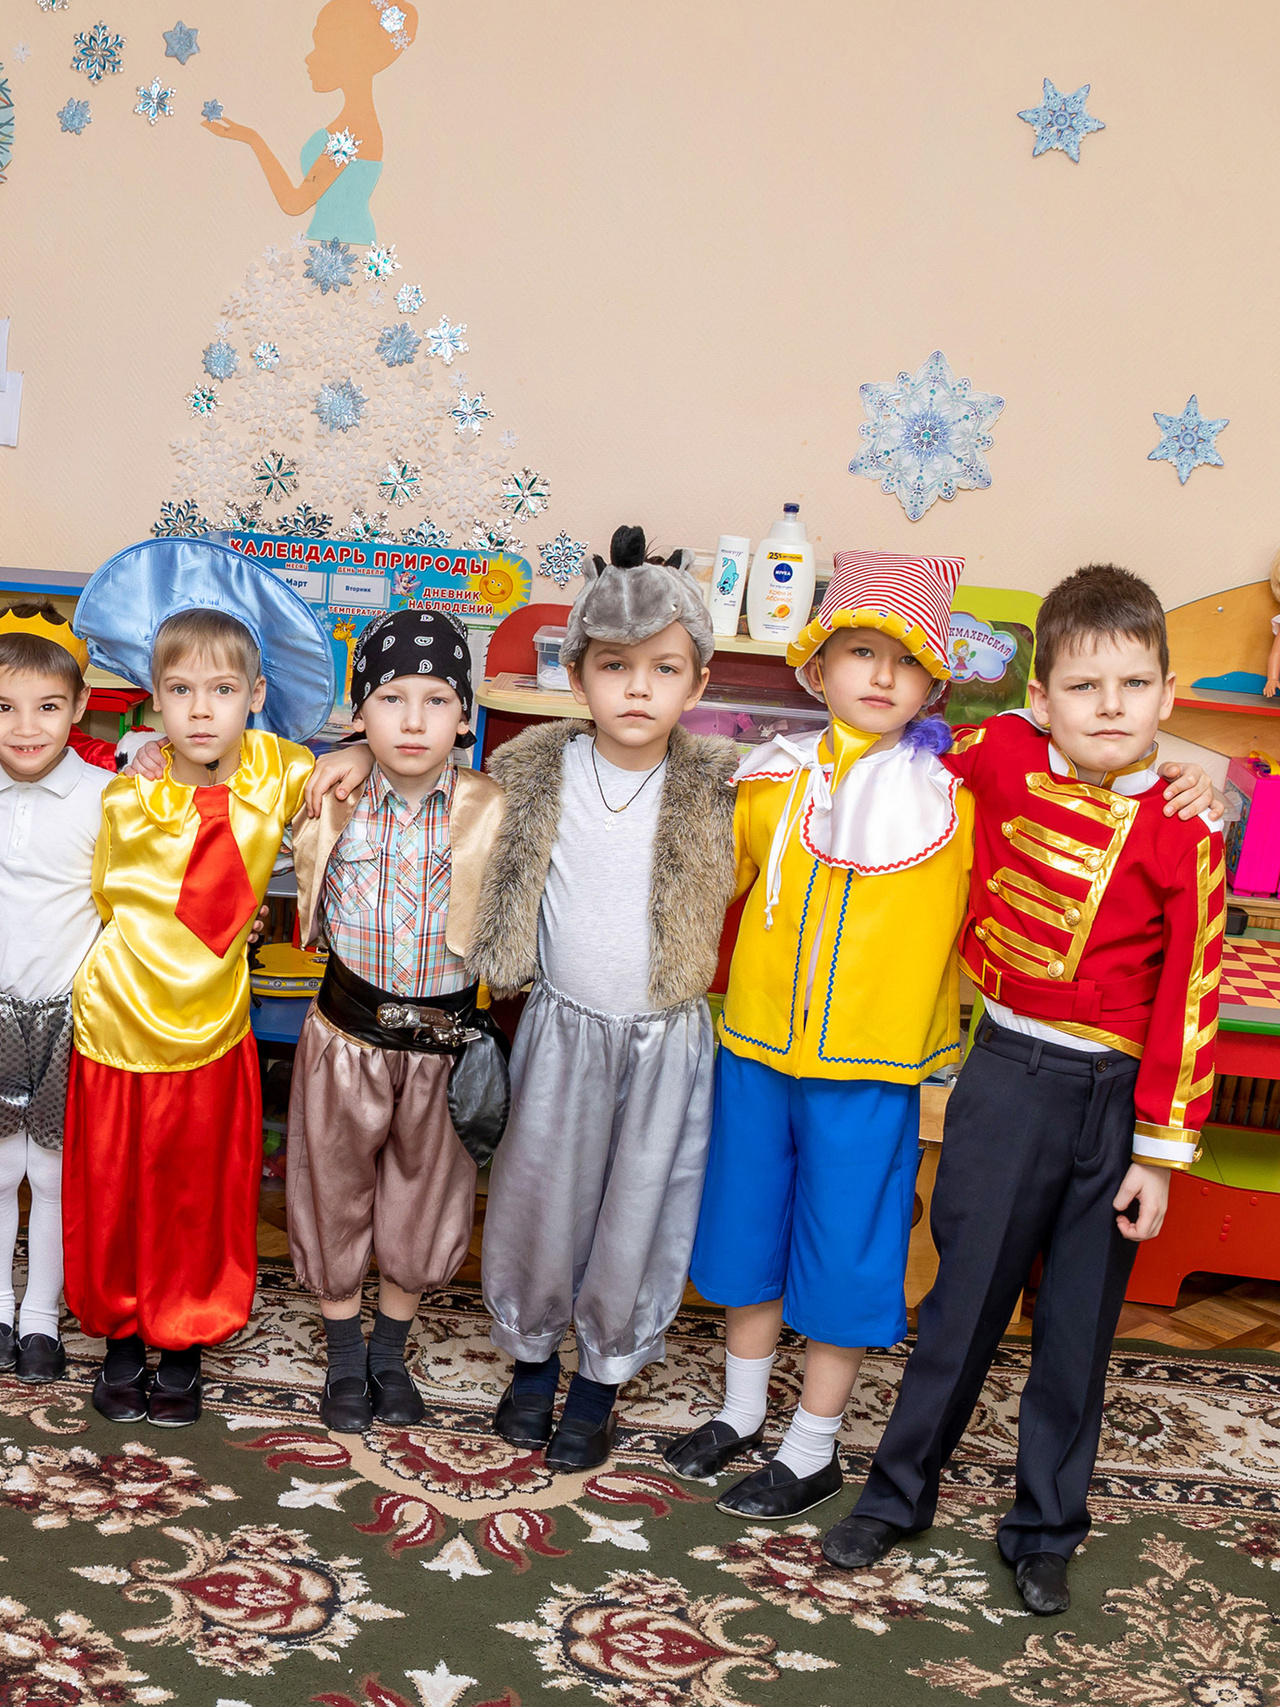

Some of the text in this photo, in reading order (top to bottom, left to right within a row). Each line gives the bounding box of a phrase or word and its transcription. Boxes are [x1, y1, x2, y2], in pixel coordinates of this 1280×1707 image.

[230, 539, 489, 576] КАЛЕНДАРЬ ПРИРОДЫ
[285, 562, 309, 571] МЕСЯЦ
[337, 566, 356, 574] ДЕНЬ
[286, 577, 308, 588] Март
[345, 585, 371, 593] Вторник
[422, 587, 482, 601] ДНЕВНИК
[328, 605, 387, 616] ТЕМПЕРАТУРА
[408, 600, 494, 615] НАБЛЮДЕНИЙ
[949, 627, 1012, 656] КМАХЕРСКАЯ
